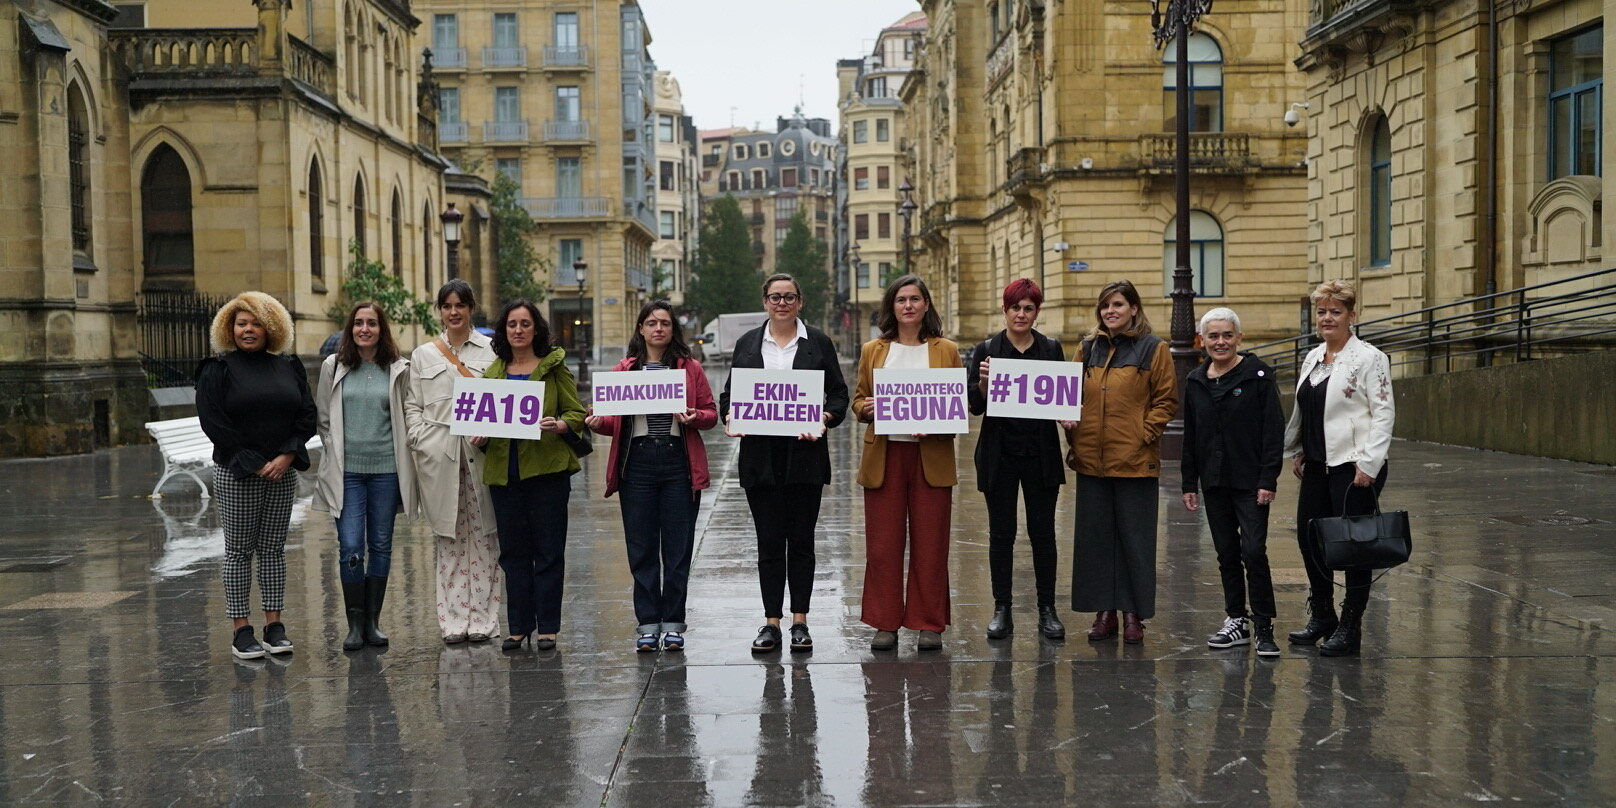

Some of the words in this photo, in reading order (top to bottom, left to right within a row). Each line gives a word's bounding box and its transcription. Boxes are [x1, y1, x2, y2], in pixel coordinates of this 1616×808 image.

[594, 383, 685, 402] EMAKUME
[753, 383, 807, 401] EKIN-
[876, 383, 964, 396] NAZIOARTEKO
[988, 373, 1078, 407] #19N
[454, 392, 541, 425] #A19
[731, 402, 821, 422] TZAILEEN
[876, 396, 966, 421] EGUNA
